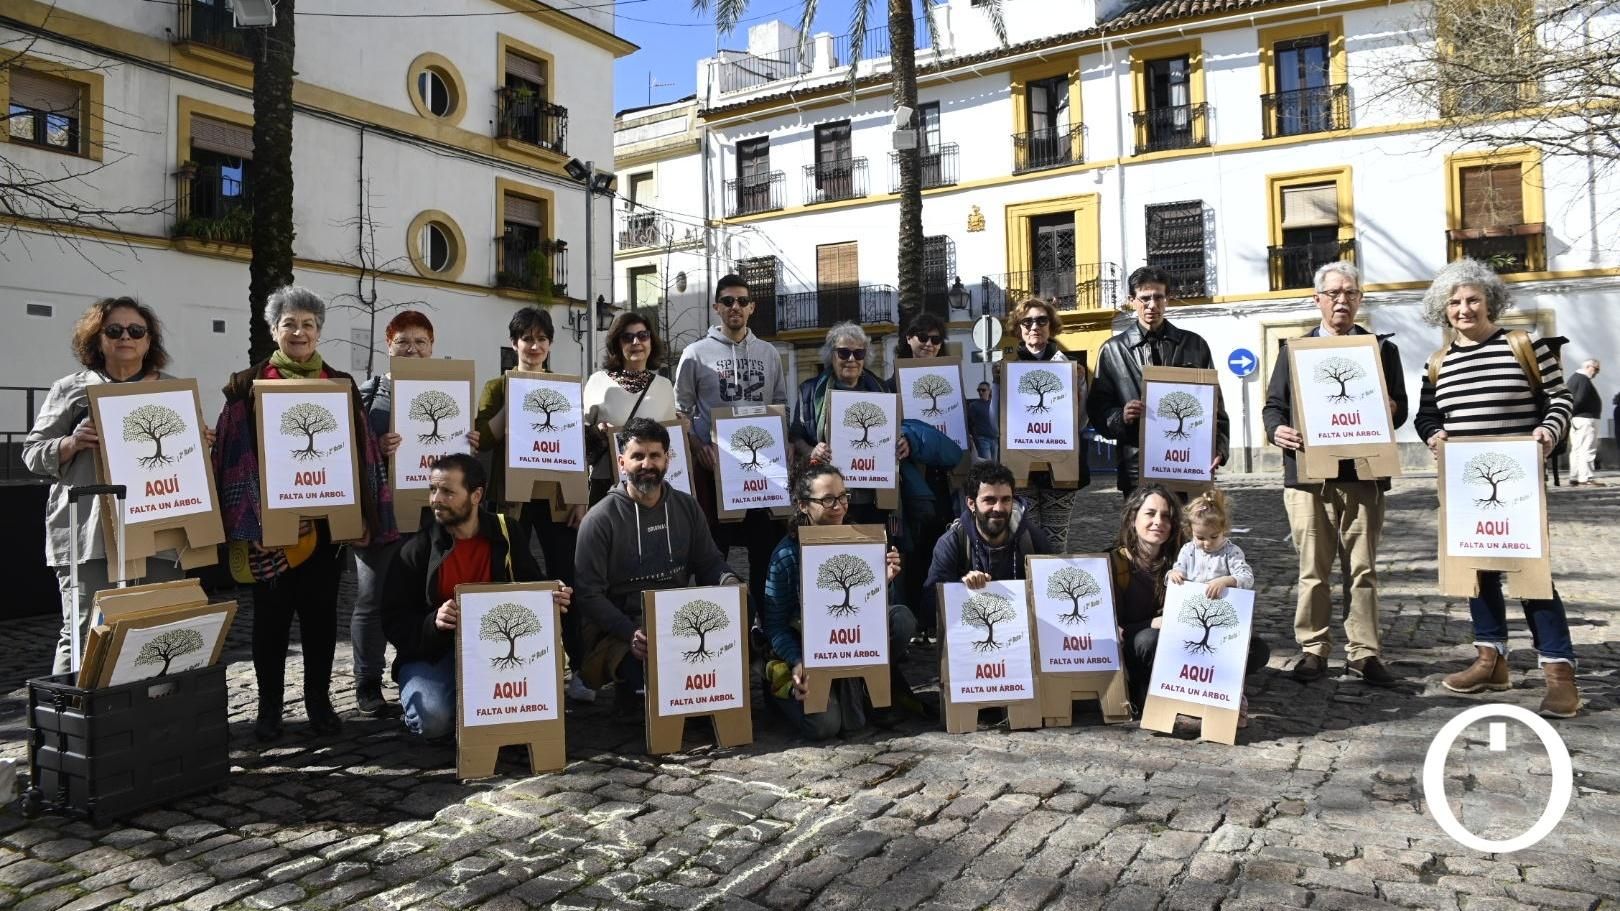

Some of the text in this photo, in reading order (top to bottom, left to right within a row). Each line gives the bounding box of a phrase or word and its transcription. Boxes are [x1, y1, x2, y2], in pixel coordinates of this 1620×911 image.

[1332, 410, 1360, 425] AQUÍ
[1027, 420, 1051, 434] AQUÍ
[1014, 437, 1033, 445] FALTA
[1046, 437, 1067, 445] ÁRBOL
[1319, 431, 1340, 439] FALTA
[533, 440, 559, 453] AQUÍ
[419, 451, 447, 469] AQ
[1165, 448, 1190, 462] AQUÍ
[851, 456, 874, 471] AQUÍ
[295, 468, 326, 486] AQUÍ
[406, 474, 427, 482] FALTA
[1172, 467, 1182, 475] UN
[145, 473, 180, 497] AQUÍ
[744, 477, 767, 491] AQUÍ
[841, 474, 857, 483] ALTA
[279, 490, 346, 500] FALTA UN ÁRBOL
[752, 495, 762, 503] UN
[130, 496, 202, 514] FALTA UN ÁRBOL
[1476, 519, 1509, 536] AQUÍ
[1460, 541, 1484, 549] FALTA
[830, 625, 860, 645] AQUÍ
[1063, 633, 1092, 651] AQUÍ
[814, 649, 880, 660] FALTA UN ÁRBOL
[1050, 656, 1112, 665] FALTA UN ÁRBOL
[976, 660, 1005, 679] AQUÍ
[1180, 664, 1214, 683] AQUÍ
[685, 670, 716, 690] AQUÍ
[493, 677, 528, 700] AQUÍ
[962, 683, 1025, 694] FALTA UN ÁRBOL
[1161, 683, 1230, 701] FALTA UN ÁRBOL
[670, 693, 735, 706] FALTA UN ÁRBOL
[477, 703, 548, 716] FALTA UN ÁRBOL
